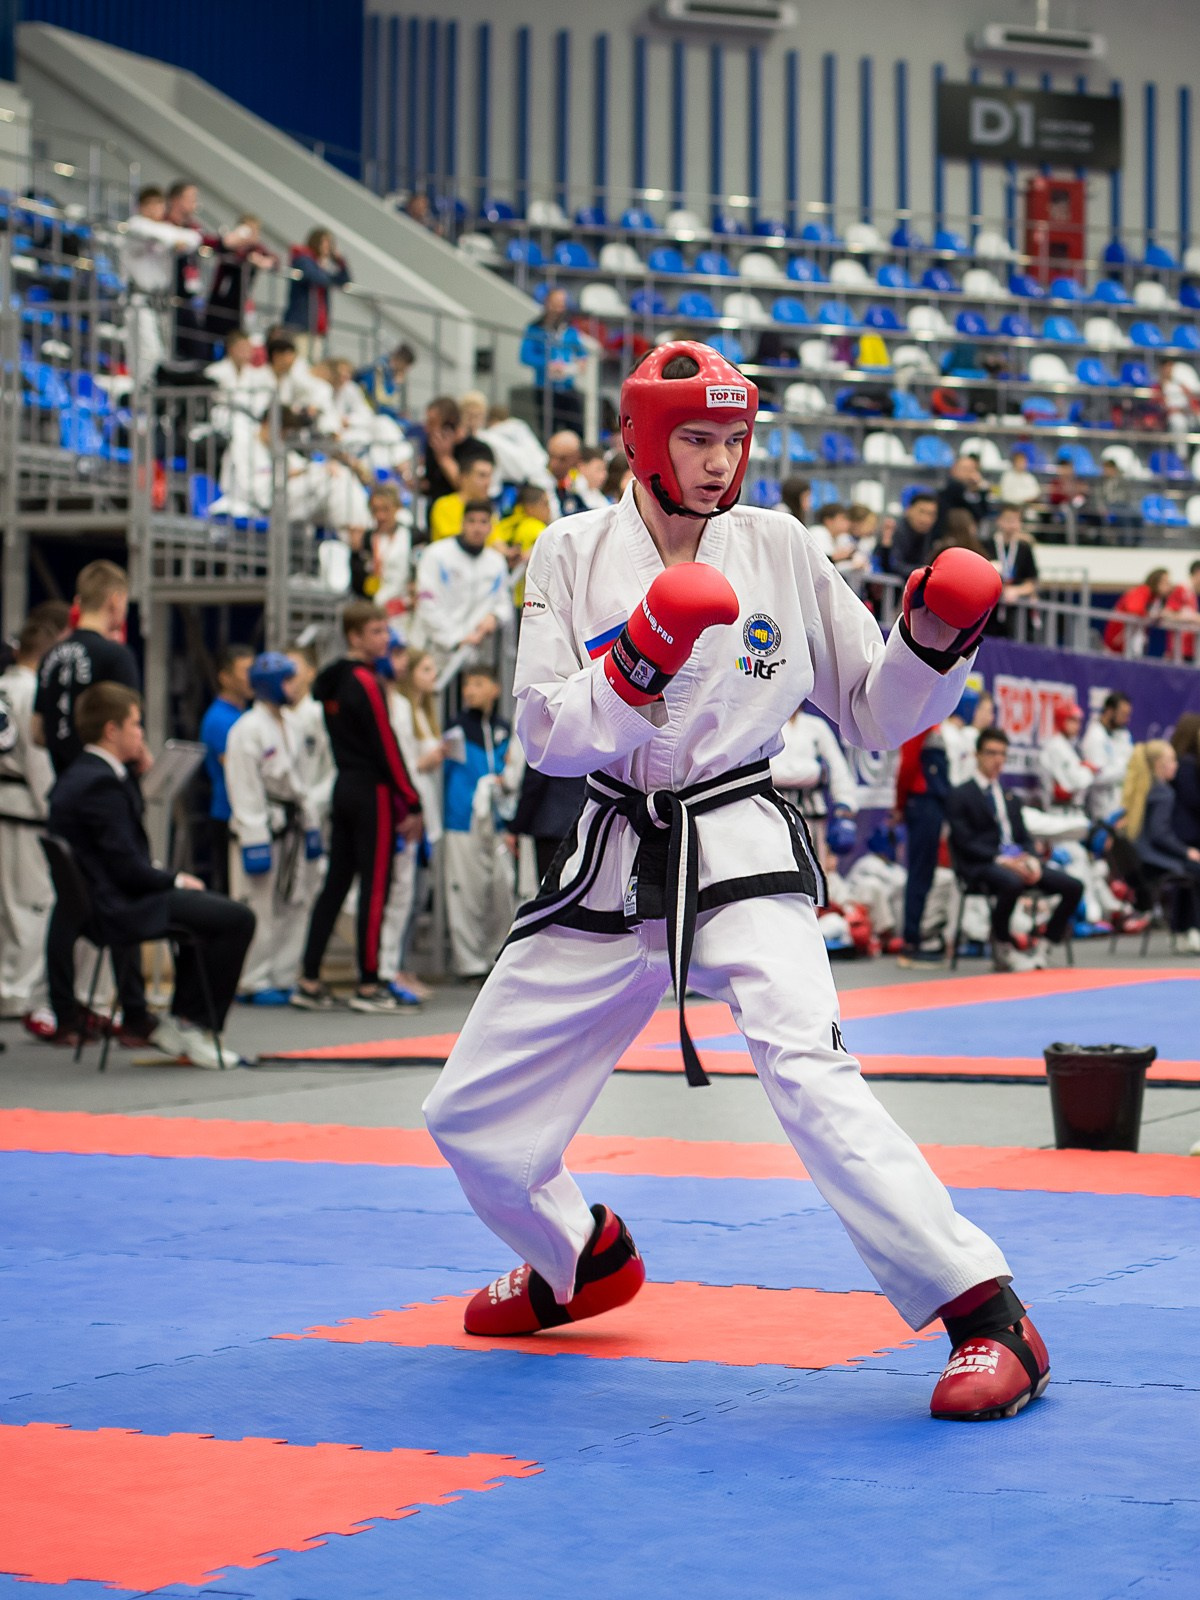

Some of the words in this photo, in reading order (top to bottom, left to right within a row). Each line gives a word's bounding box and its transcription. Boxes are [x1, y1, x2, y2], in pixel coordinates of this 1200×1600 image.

[969, 96, 1034, 148] D1
[710, 392, 729, 401] TOP
[730, 392, 746, 402] TEN
[656, 625, 675, 645] PRO
[965, 1354, 999, 1369] TEN
